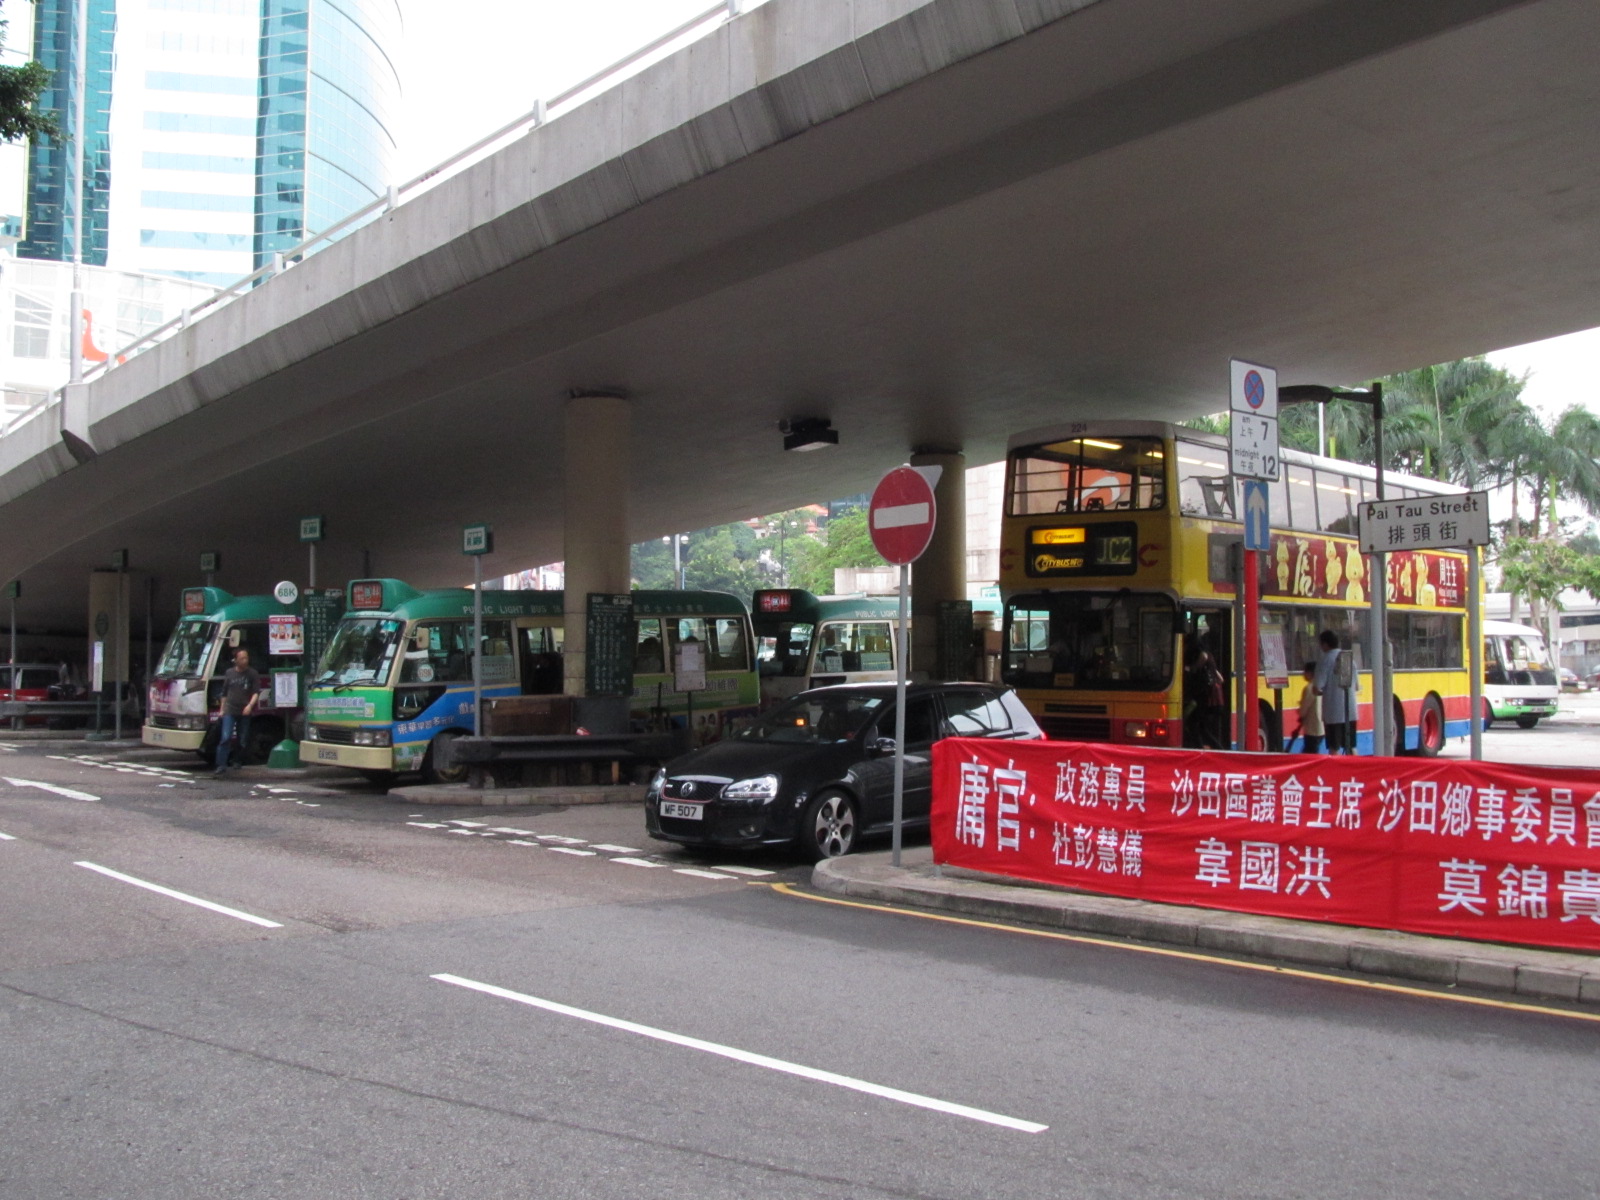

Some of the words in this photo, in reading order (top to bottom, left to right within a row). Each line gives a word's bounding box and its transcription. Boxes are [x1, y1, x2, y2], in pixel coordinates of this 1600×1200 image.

[1242, 416, 1250, 424] am
[1240, 426, 1254, 439] 上午
[1261, 421, 1269, 441] 7
[1235, 448, 1260, 461] midnight
[1262, 455, 1276, 475] 12
[1367, 506, 1388, 521] Pai
[1398, 503, 1422, 518] Tau
[1430, 499, 1478, 516] Street
[1387, 521, 1458, 545] 排頭街
[278, 587, 296, 598] 68K
[463, 605, 494, 615] PULIC
[500, 604, 524, 614] LIGHT
[855, 610, 877, 618] PUBLIC
[880, 610, 897, 618] LIGHT
[1054, 759, 1146, 813] 政務專員
[1171, 769, 1364, 830] 沙田區議會主席
[678, 805, 697, 817] 507
[1052, 821, 1144, 878] 杜彭慧儀
[1194, 837, 1331, 899] 韋國洪
[1437, 858, 1600, 924] 莫錦貴
